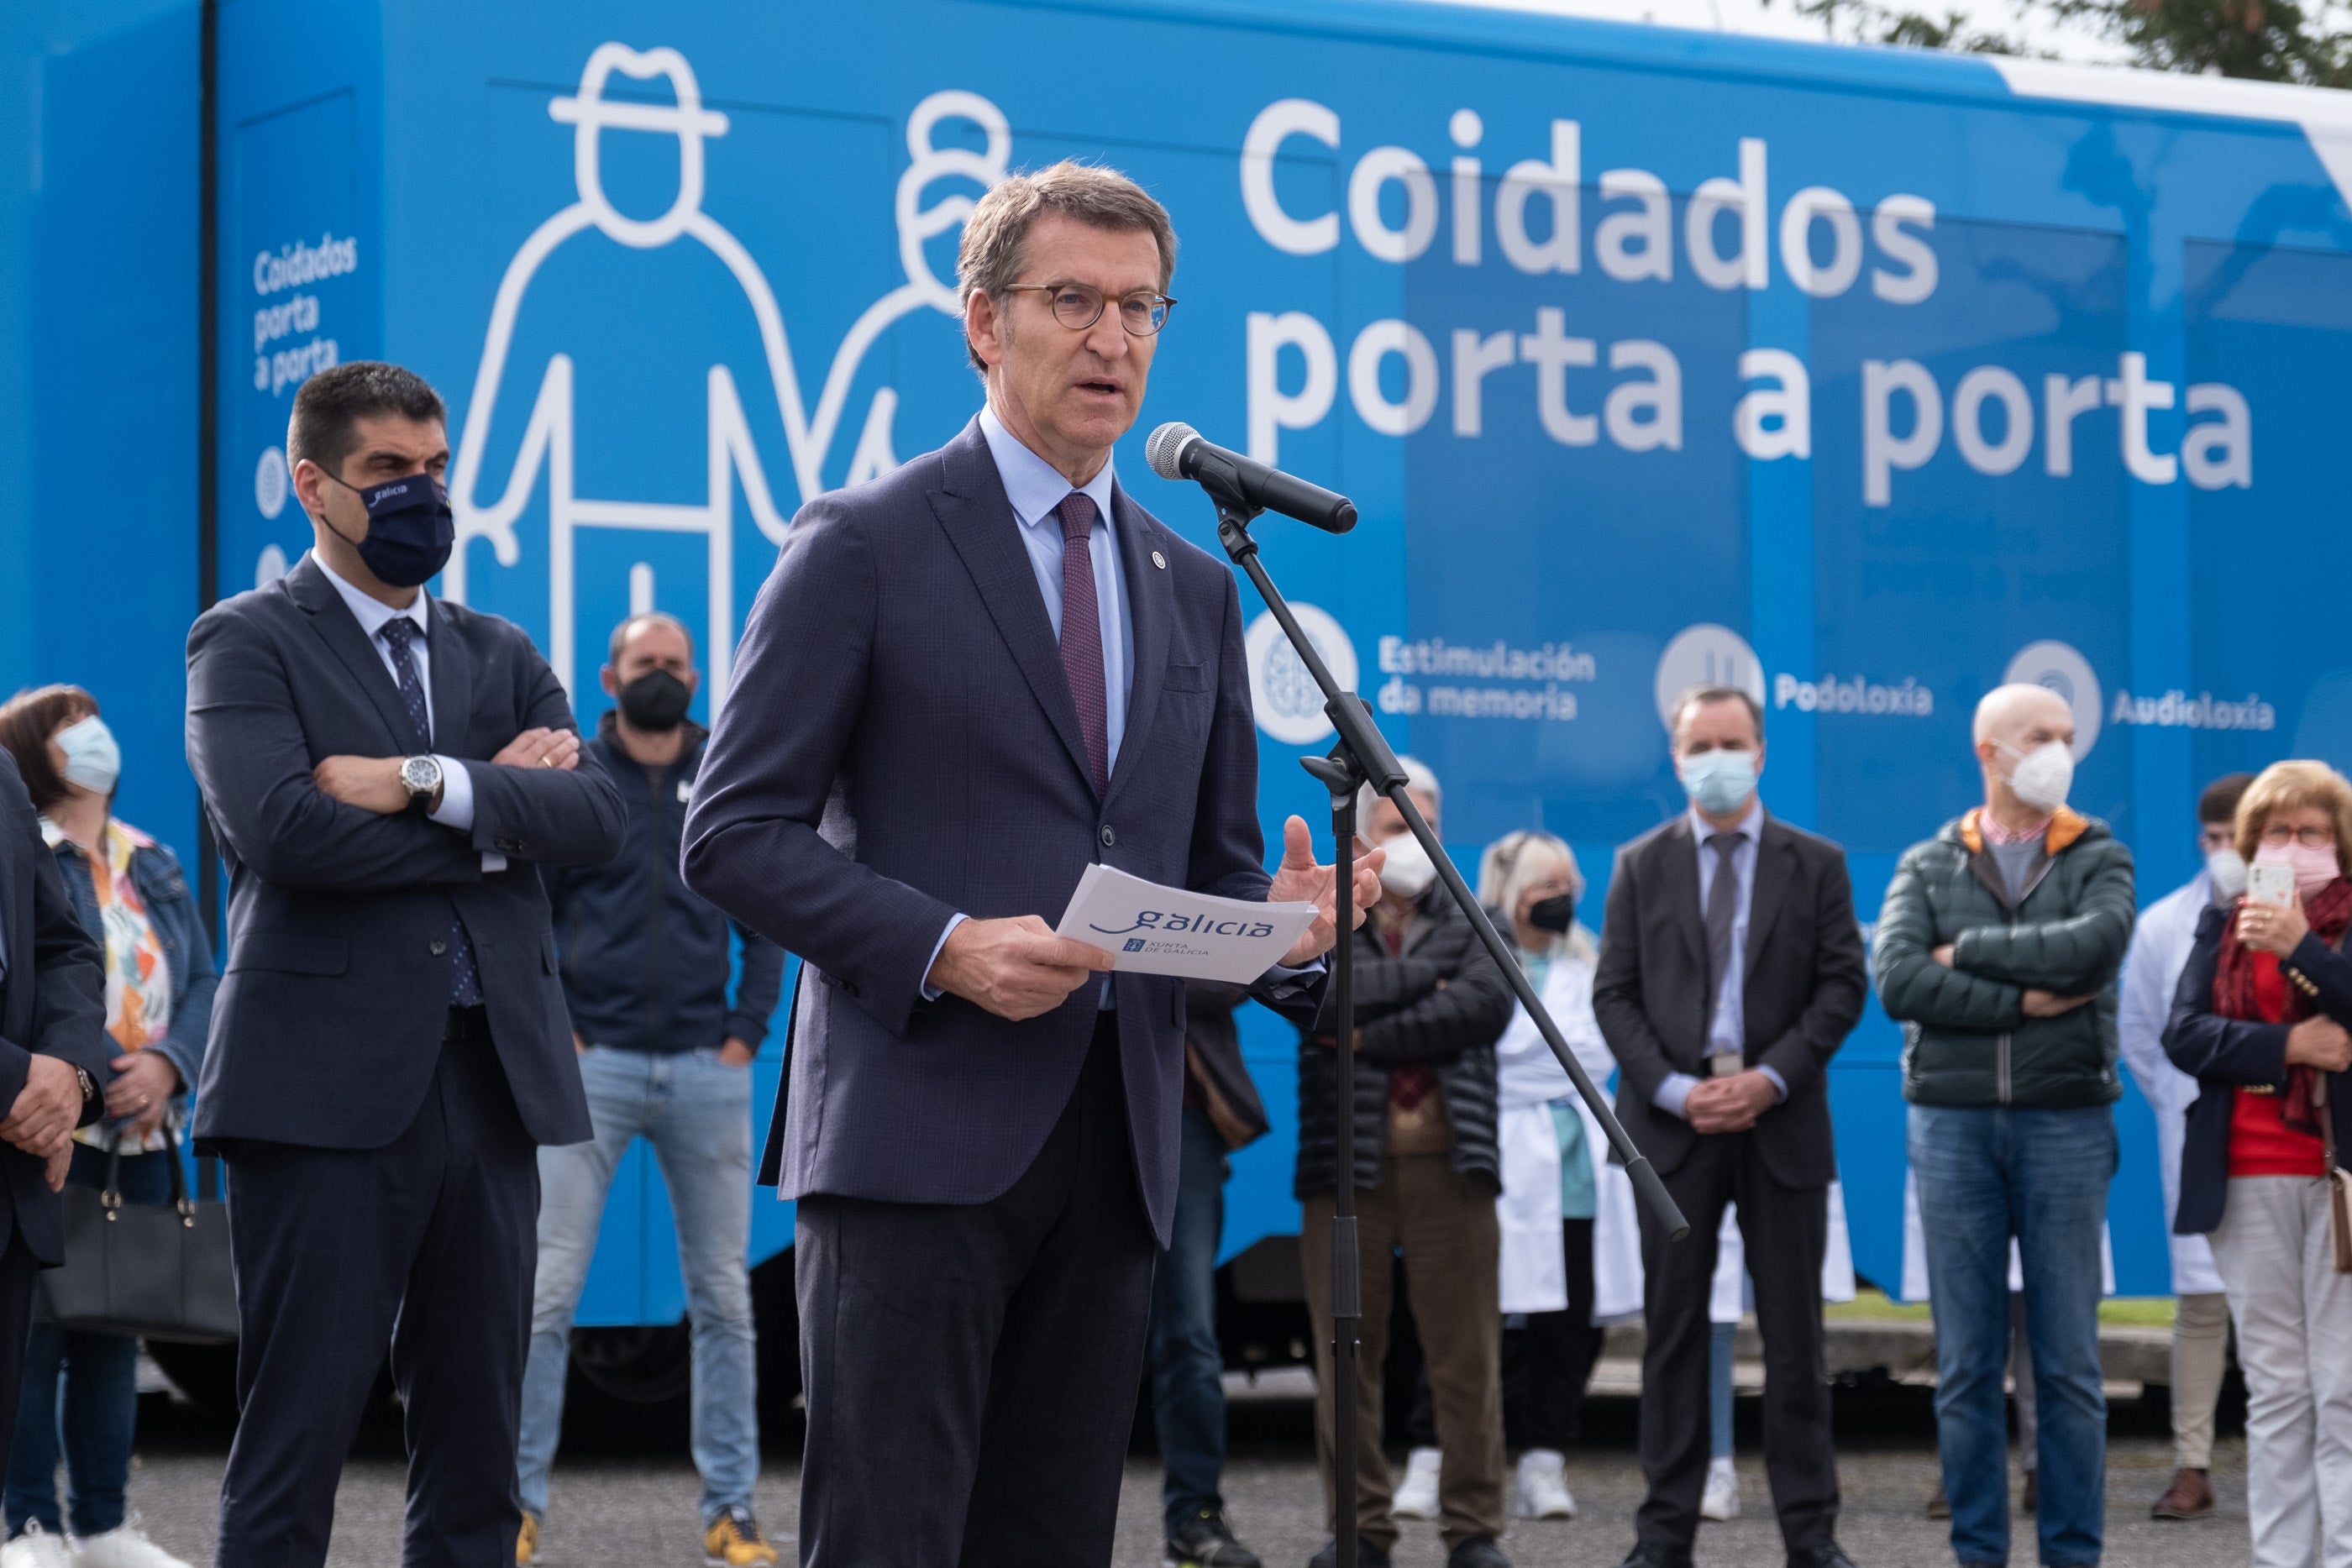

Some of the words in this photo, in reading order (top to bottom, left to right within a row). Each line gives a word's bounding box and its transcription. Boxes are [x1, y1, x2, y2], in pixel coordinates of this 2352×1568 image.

[1239, 97, 1940, 306] Coidados
[254, 231, 357, 295] Coidados
[254, 294, 319, 354] porta
[255, 356, 270, 390] a
[273, 337, 339, 397] porta
[1245, 307, 1683, 468] porta
[1734, 347, 1811, 460] a
[1862, 351, 2253, 506] porta
[369, 485, 408, 507] galicia
[1378, 636, 1596, 681] Estimulación
[1378, 676, 1421, 713] da
[1428, 684, 1578, 720] memoria
[1774, 674, 1933, 716] Podoloxía
[2112, 690, 2276, 731] Audioloxía
[1089, 910, 1274, 937] galicia
[1148, 941, 1188, 949] XUNTA
